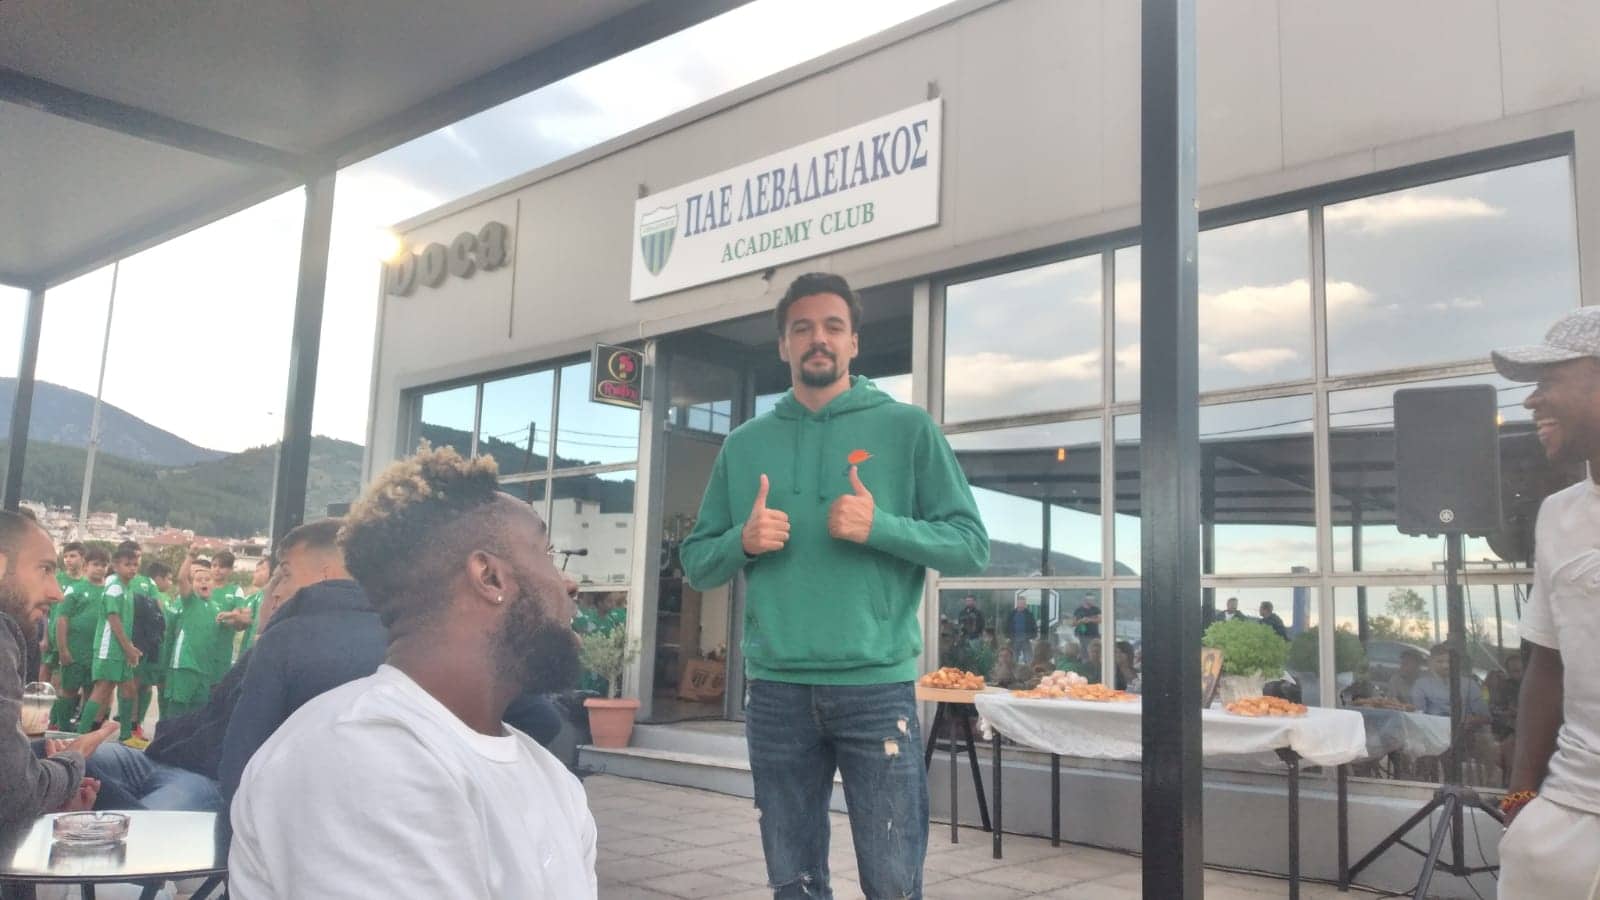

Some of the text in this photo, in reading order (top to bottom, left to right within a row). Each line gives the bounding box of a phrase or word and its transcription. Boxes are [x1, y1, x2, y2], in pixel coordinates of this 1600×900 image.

[684, 119, 929, 238] ΠΑΕ ΛΕΒΑΔΕΙΑΚΟΣ
[720, 219, 813, 264] ACADEMY
[820, 202, 875, 235] CLUB
